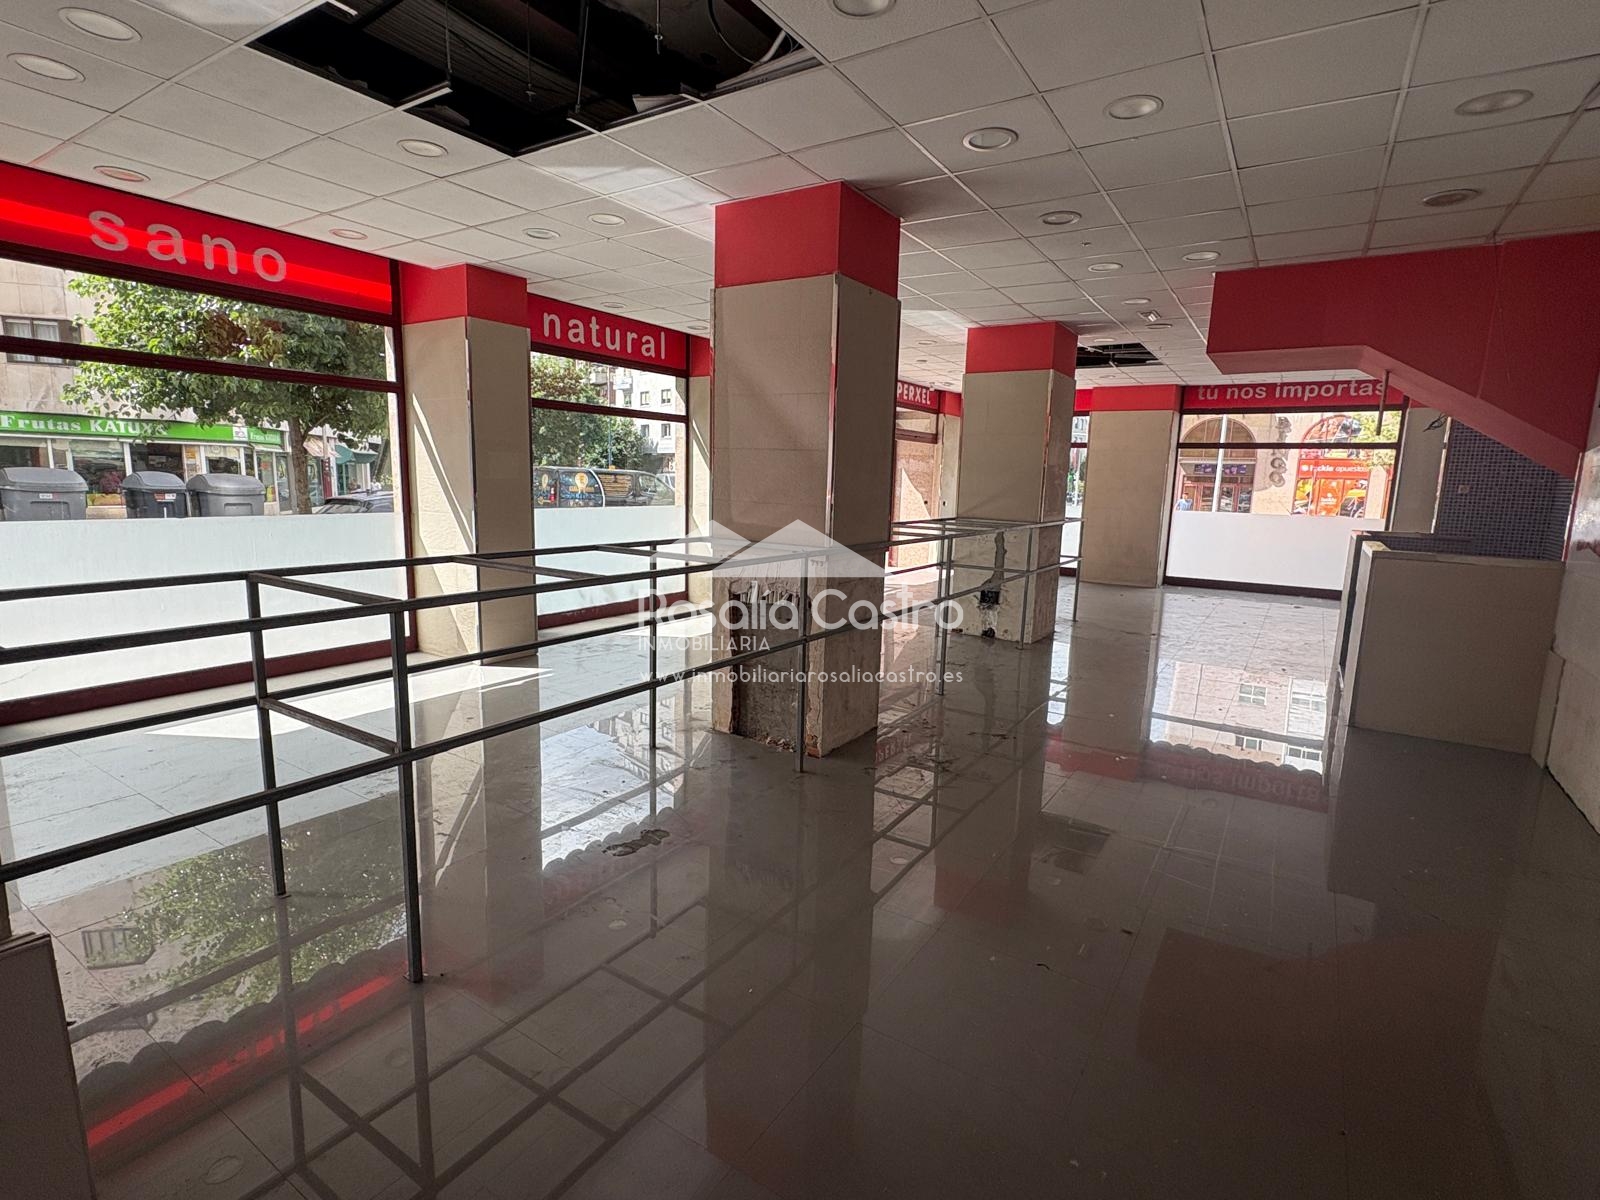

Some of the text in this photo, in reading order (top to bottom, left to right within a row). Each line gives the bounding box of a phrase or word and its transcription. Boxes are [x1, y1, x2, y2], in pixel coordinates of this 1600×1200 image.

[89, 211, 287, 282] sano
[542, 312, 667, 360] natural
[1226, 384, 1267, 399] nos
[1275, 381, 1384, 401] importas
[0, 415, 81, 431] Frutas
